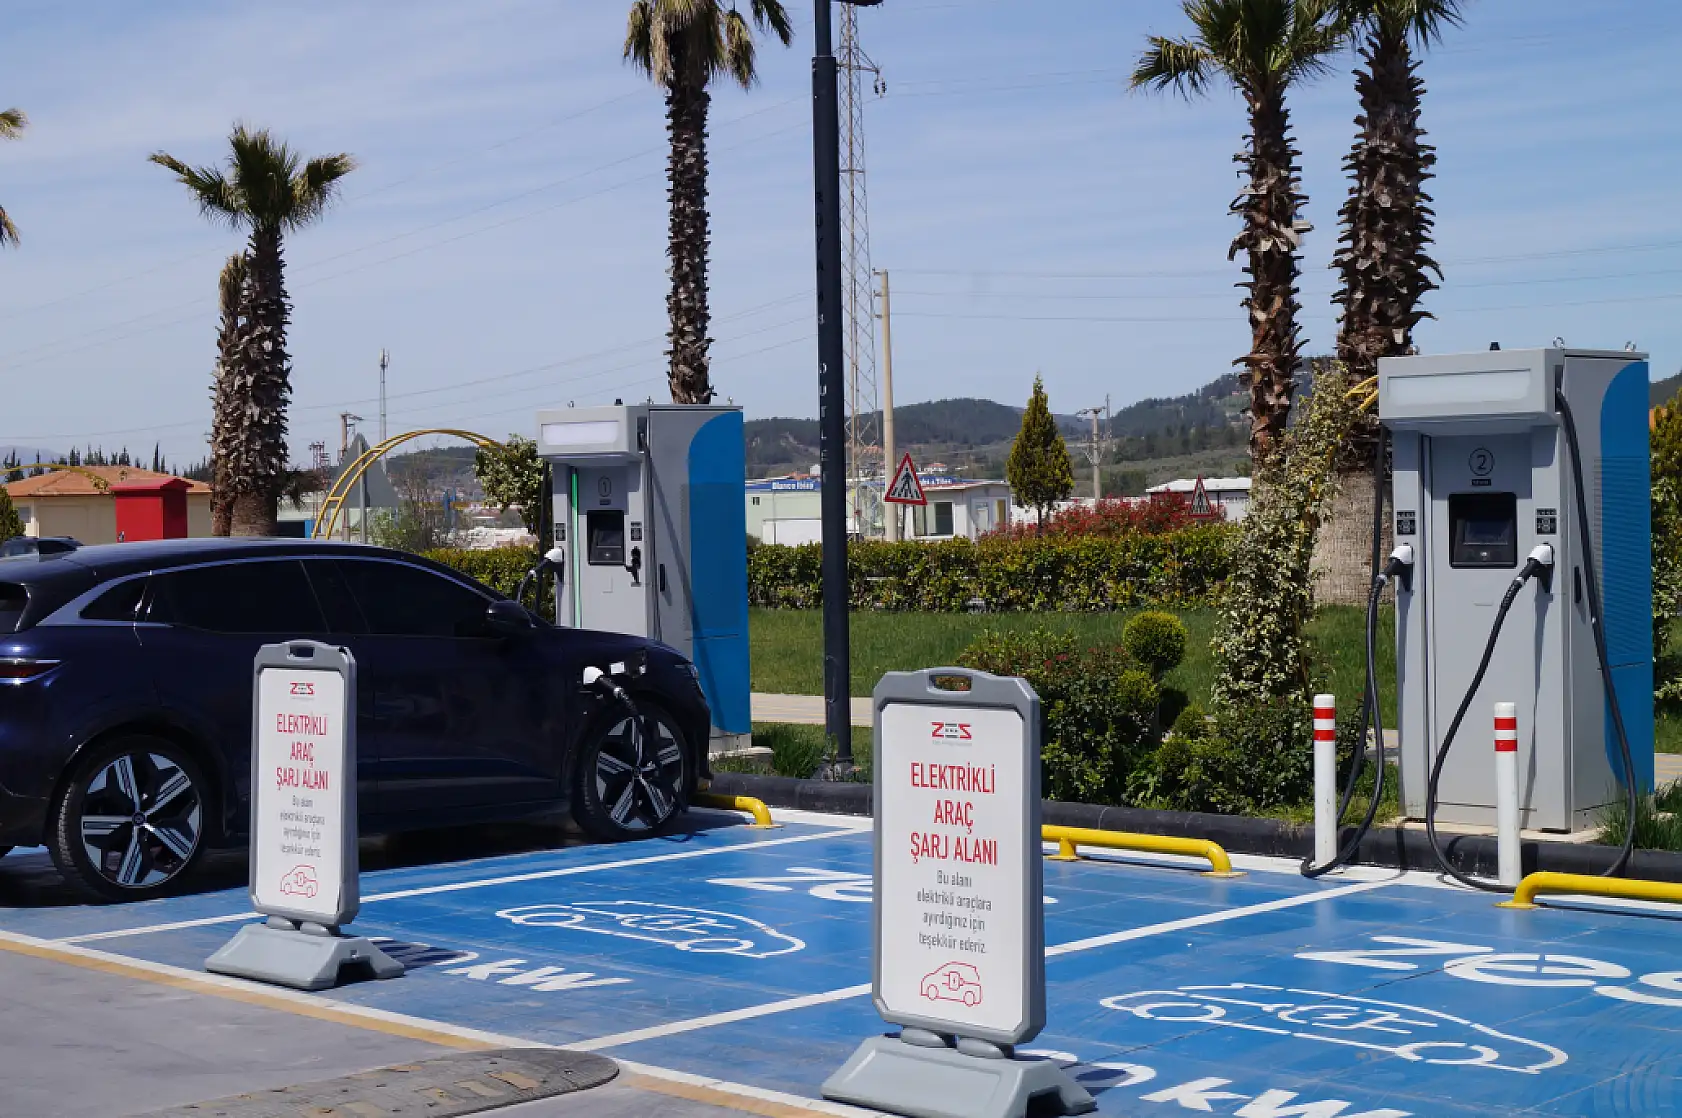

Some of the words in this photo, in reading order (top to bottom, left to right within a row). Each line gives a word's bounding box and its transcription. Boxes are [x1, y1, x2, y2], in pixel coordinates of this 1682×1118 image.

[290, 683, 315, 695] ZES
[277, 712, 327, 735] ELEKTRİKLİ
[931, 721, 972, 740] ZES
[290, 742, 313, 768] ARAÇ
[277, 767, 299, 790] ŞARJ
[303, 769, 328, 790] ALANI
[911, 762, 994, 794] ELEKTRİKLİ
[933, 800, 973, 835] ARAÇ
[911, 832, 948, 864] ŞARJ
[954, 836, 997, 865] ALANI
[937, 870, 949, 884] Bu
[952, 872, 971, 887] alanı
[917, 888, 954, 906] elektrikli
[957, 895, 991, 913] araçlara
[923, 911, 967, 929] ayırdığınız
[970, 914, 985, 934] için
[919, 932, 957, 949] teşekkür
